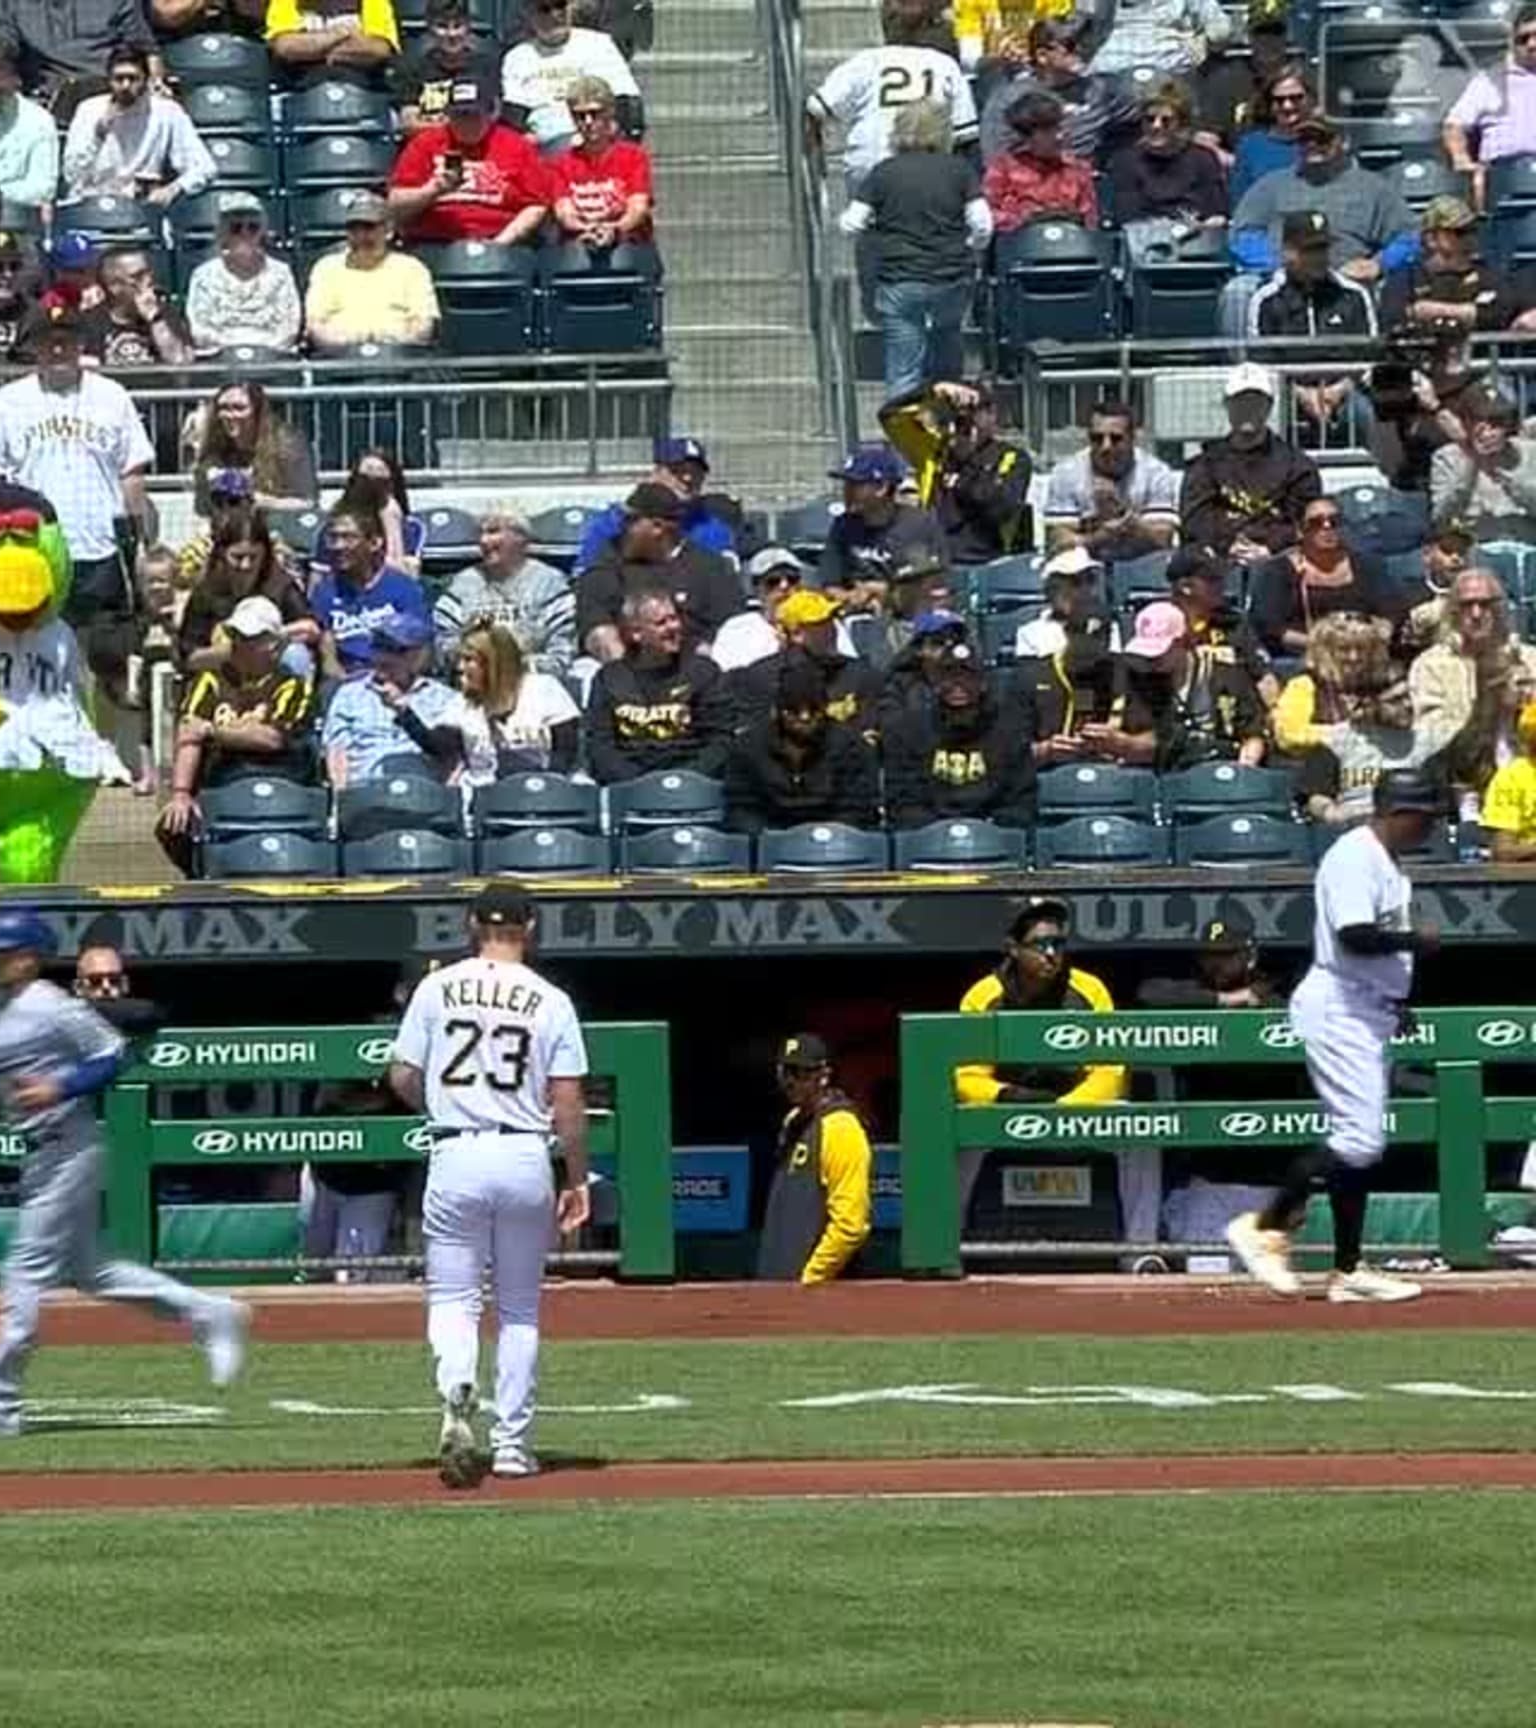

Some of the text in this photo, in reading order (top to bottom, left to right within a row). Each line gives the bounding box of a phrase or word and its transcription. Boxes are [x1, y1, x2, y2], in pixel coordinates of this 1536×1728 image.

[879, 66, 934, 107] 21
[122, 907, 311, 955] MAX
[414, 898, 909, 950] BLLY MAX
[442, 978, 543, 1017] KELLER
[196, 1043, 315, 1063] HYUNDAI
[440, 1019, 532, 1091] 23
[1096, 1026, 1217, 1047] HYUNDAI
[243, 1129, 363, 1151] HYUNDAI
[1057, 1115, 1180, 1137] HYUNDAI
